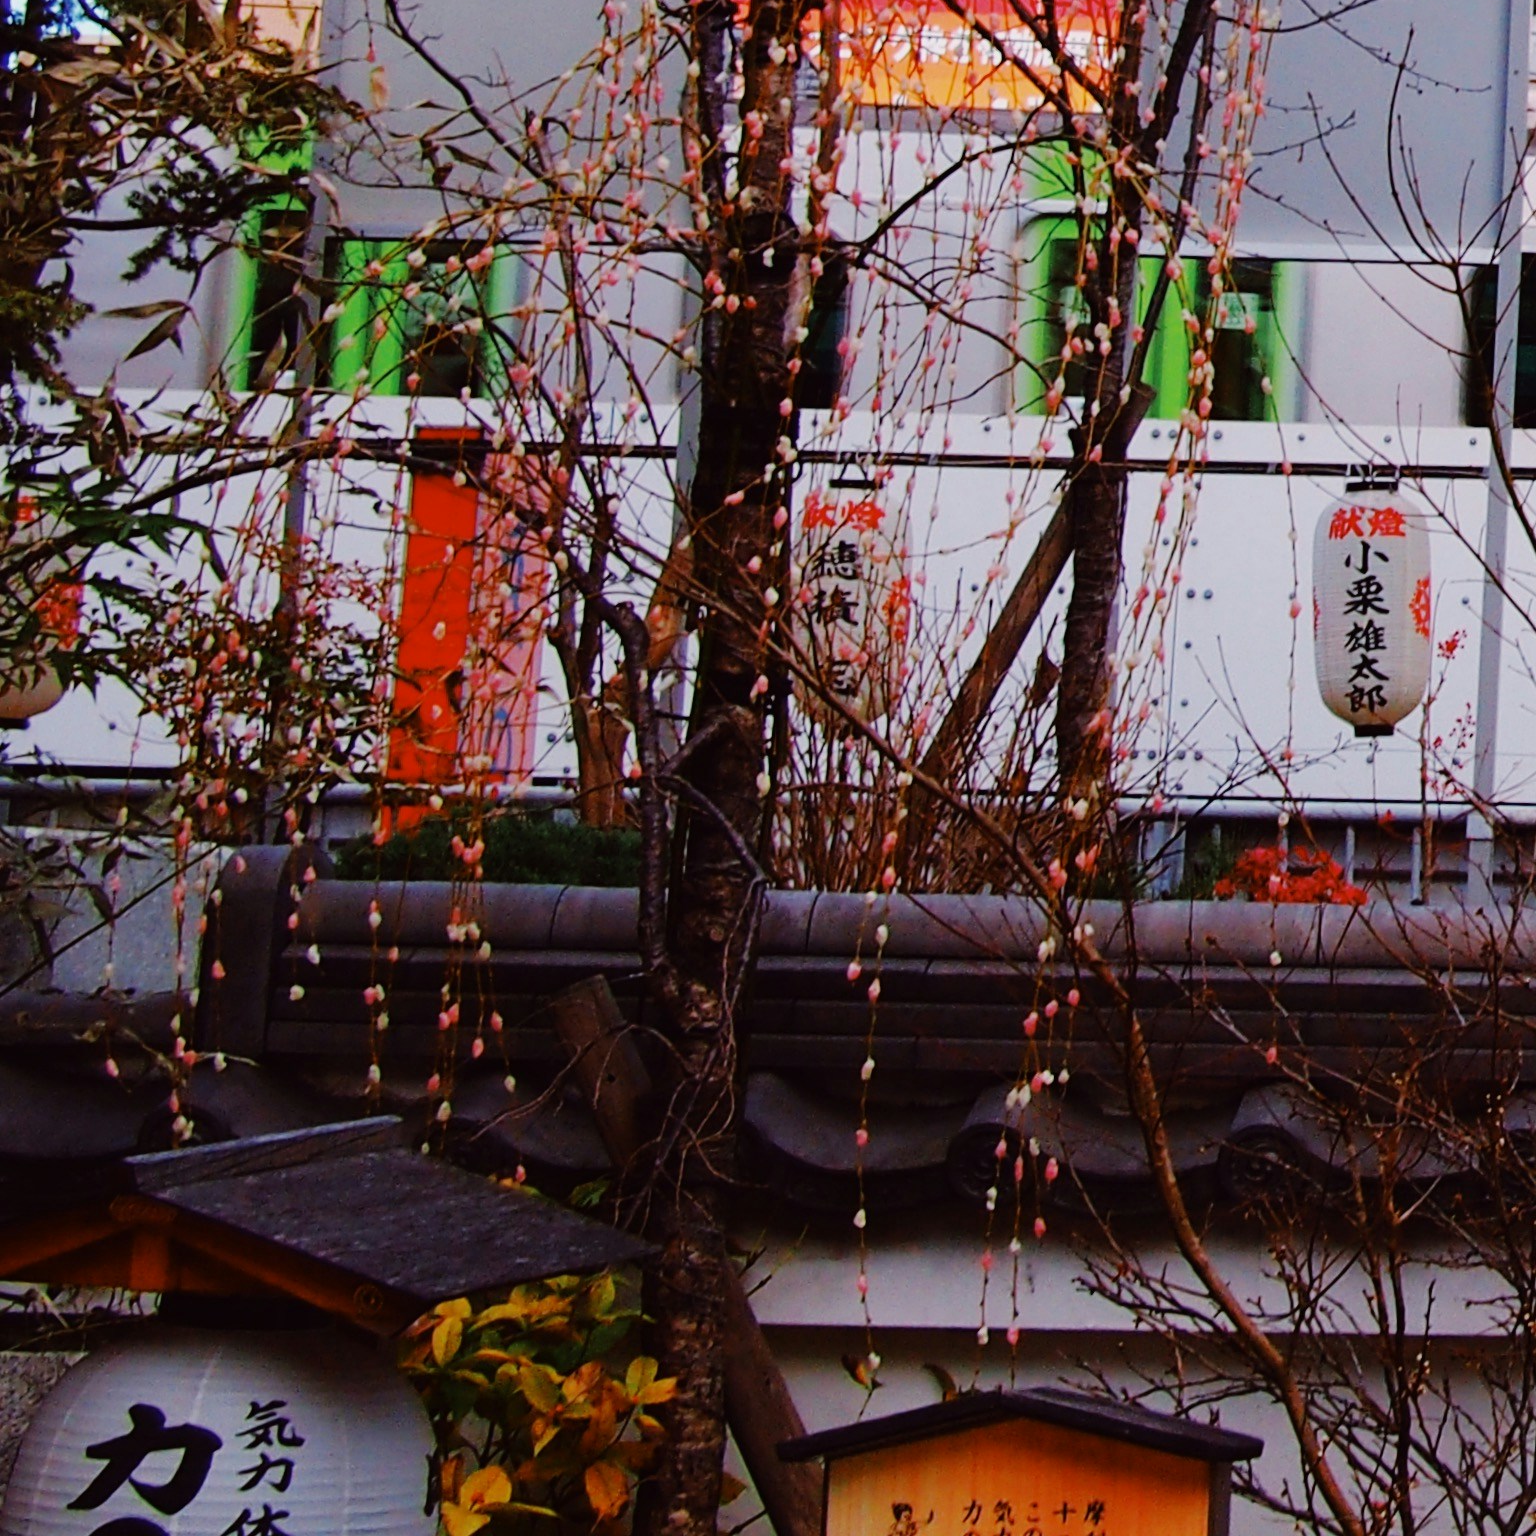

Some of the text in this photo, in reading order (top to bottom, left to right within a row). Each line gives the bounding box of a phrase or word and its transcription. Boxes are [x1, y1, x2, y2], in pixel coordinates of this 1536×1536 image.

[1343, 540, 1390, 714] 小栗雄太郎
